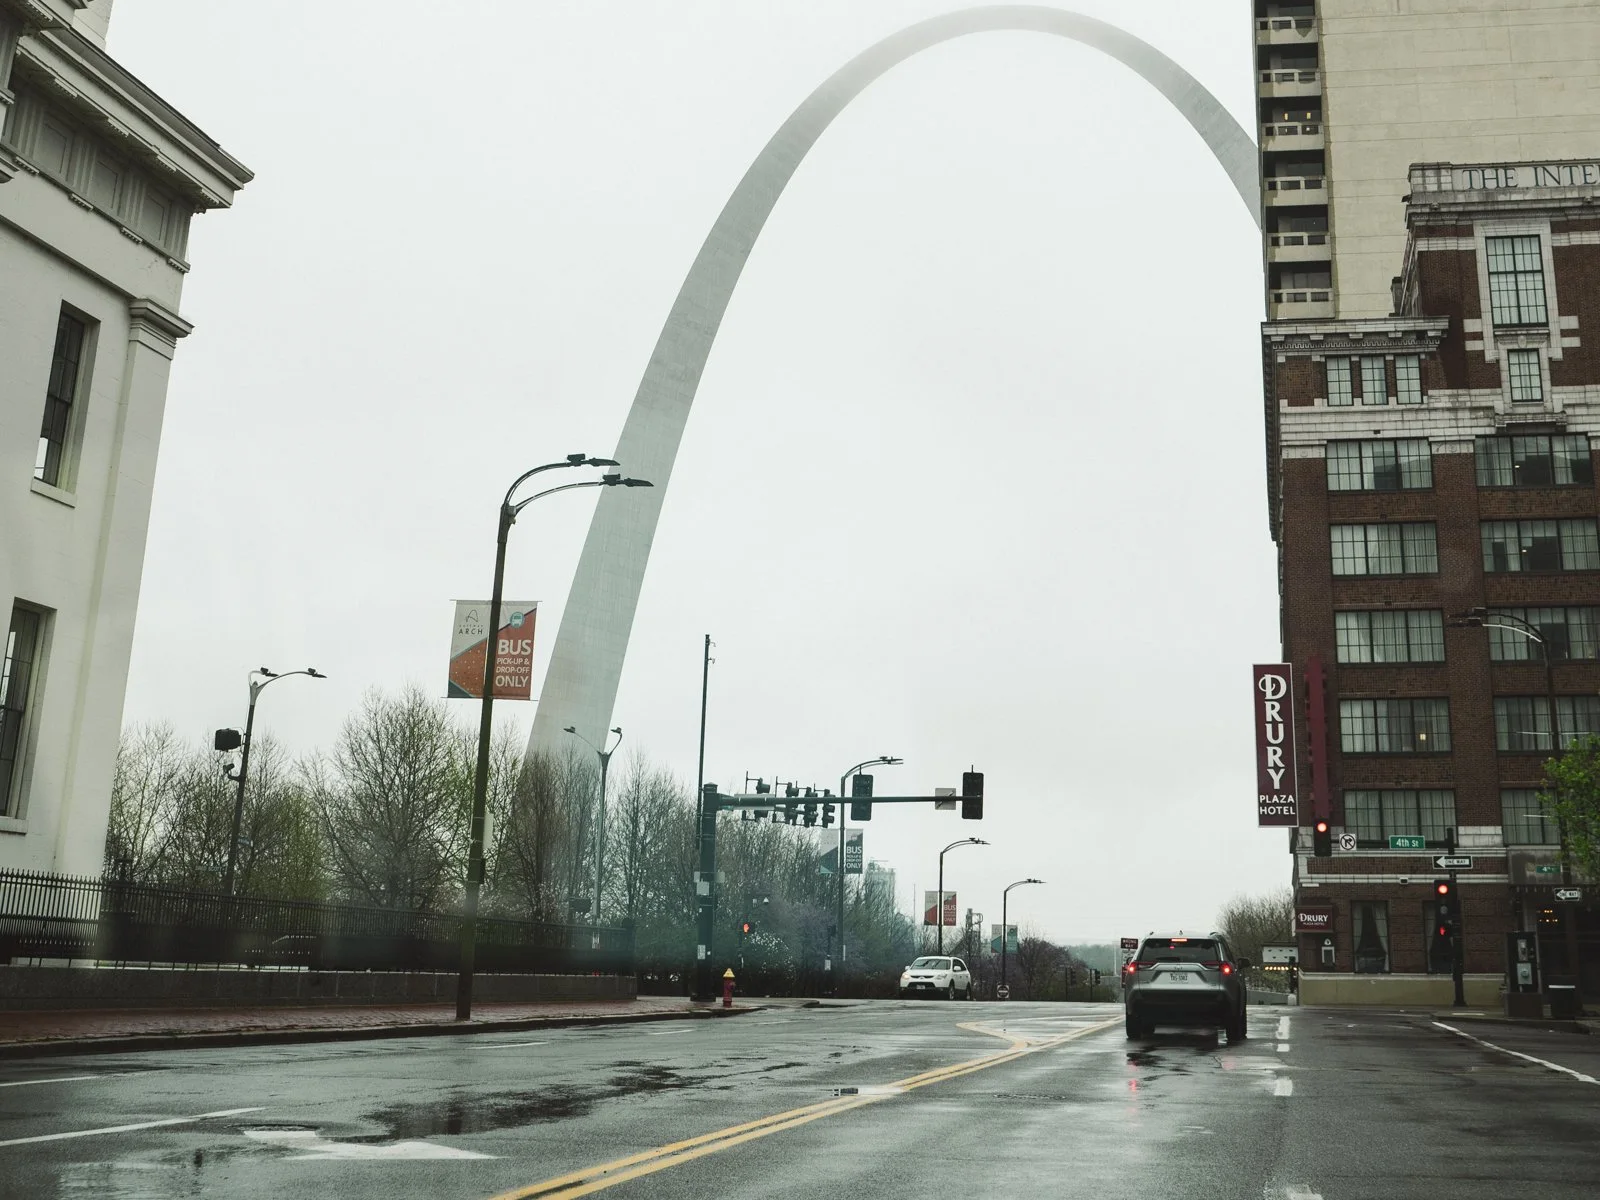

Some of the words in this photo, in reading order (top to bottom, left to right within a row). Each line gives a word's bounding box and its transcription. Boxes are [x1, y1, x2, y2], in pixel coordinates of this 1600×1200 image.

[1462, 167, 1519, 190] THE
[1532, 164, 1600, 187] INTE
[497, 639, 532, 655] BUS
[496, 657, 523, 665] PICK-UP
[523, 657, 530, 665] &
[495, 666, 531, 674] DROP-OFF
[495, 675, 529, 687] ONLY
[1258, 674, 1288, 790] DRURY
[1259, 794, 1295, 804] PLAZA
[1259, 806, 1296, 815] HOTEL
[1395, 838, 1410, 847] 4th
[846, 846, 862, 854] BUS
[1298, 913, 1328, 922] DRURY
